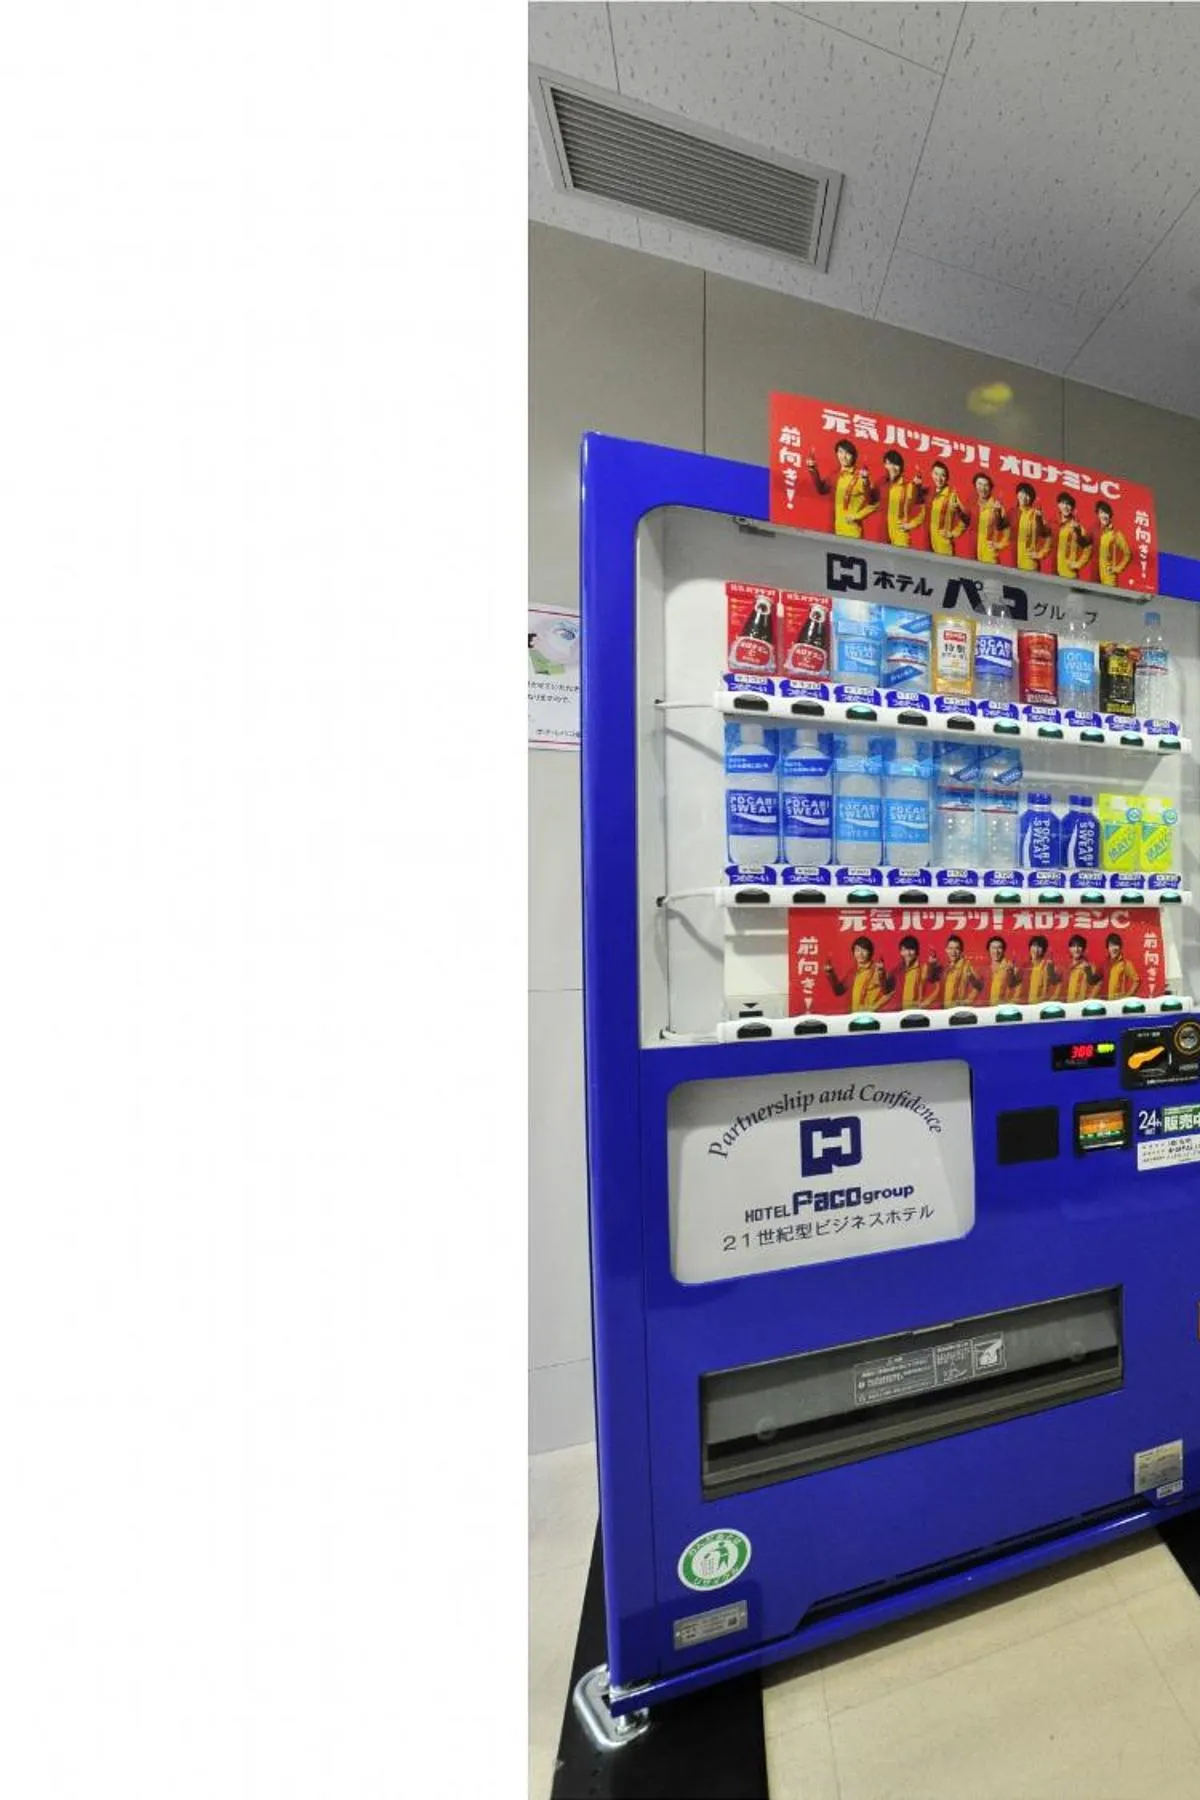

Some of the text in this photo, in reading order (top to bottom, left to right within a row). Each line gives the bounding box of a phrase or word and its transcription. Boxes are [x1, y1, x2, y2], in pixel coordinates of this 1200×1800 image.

[999, 454, 1121, 500] オロナミンC
[873, 570, 934, 598] ホテル
[1012, 910, 1131, 930] オロナミンC
[708, 1083, 943, 1160] Partnership and Confidence
[744, 1184, 915, 1223] HOTEL Paco group
[722, 1204, 935, 1252] 21世紀型ビジネスホテル
